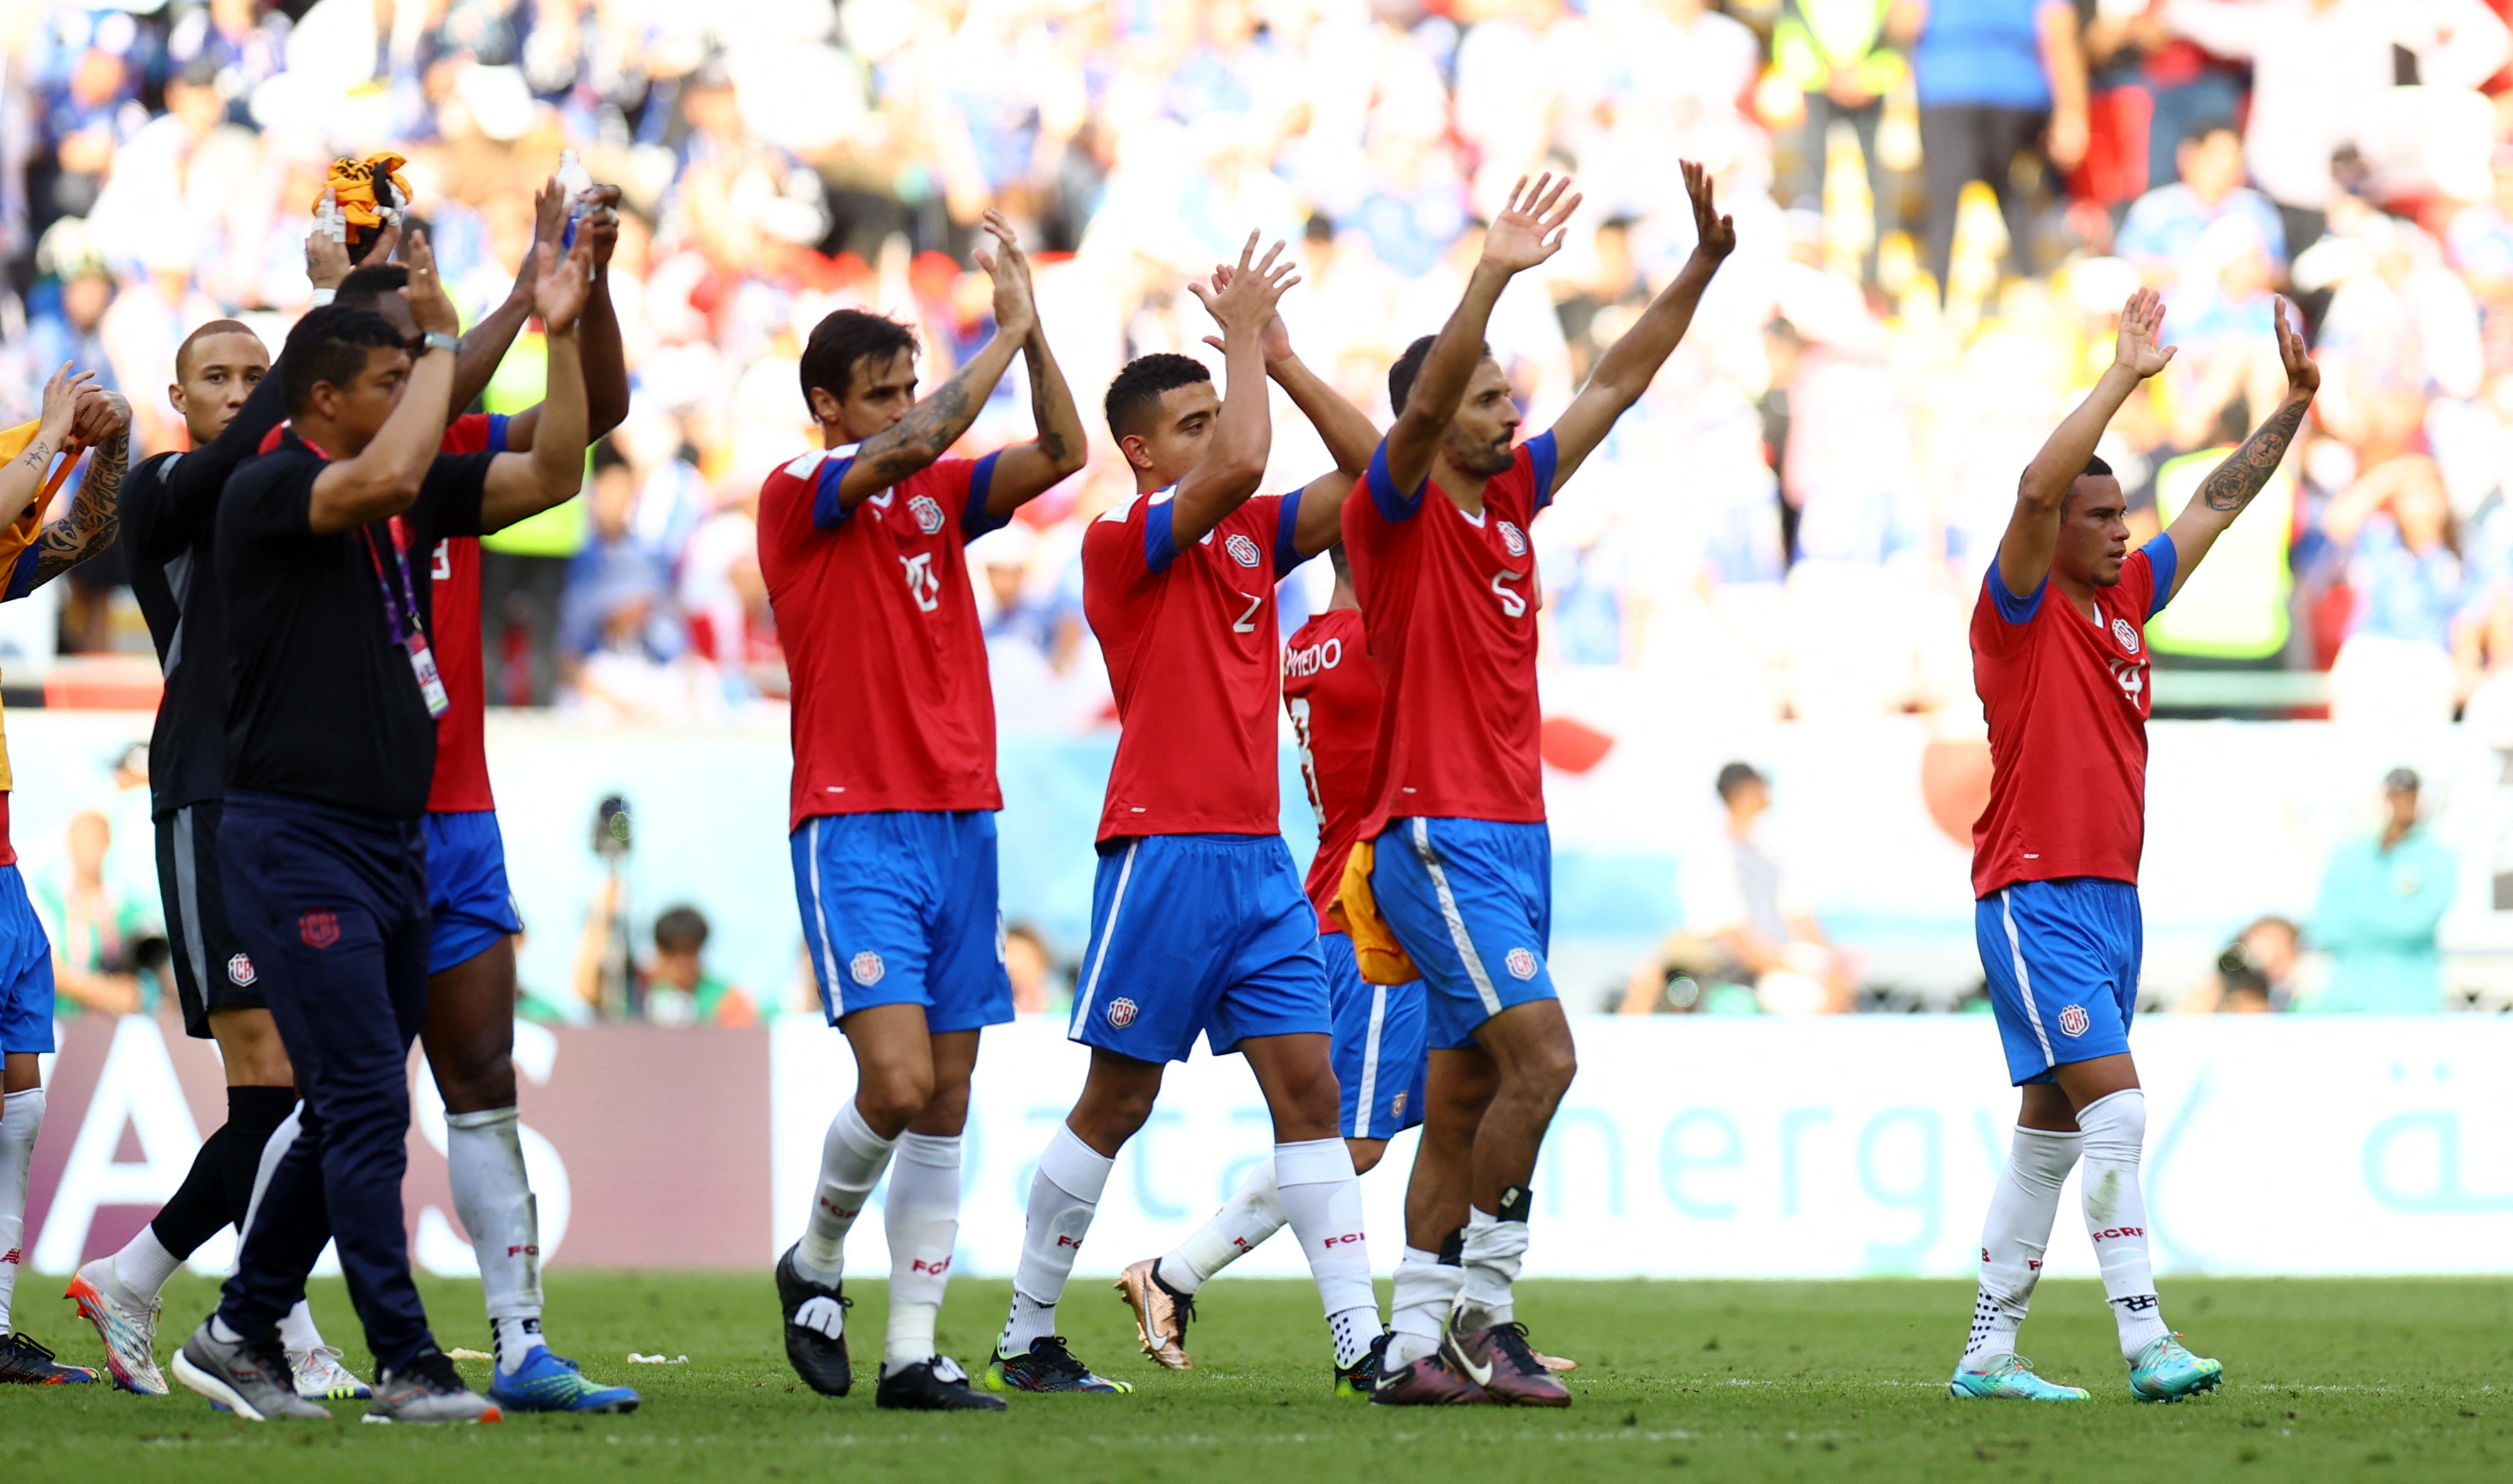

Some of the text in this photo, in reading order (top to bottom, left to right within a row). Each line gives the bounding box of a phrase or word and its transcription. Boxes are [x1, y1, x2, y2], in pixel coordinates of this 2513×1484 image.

[1232, 538, 1257, 562] CR
[1490, 569, 1526, 618] 5
[1233, 591, 1262, 633] 2
[236, 960, 253, 980] CR
[1113, 1004, 1134, 1024] CR
[2063, 1011, 2083, 1031] CR
